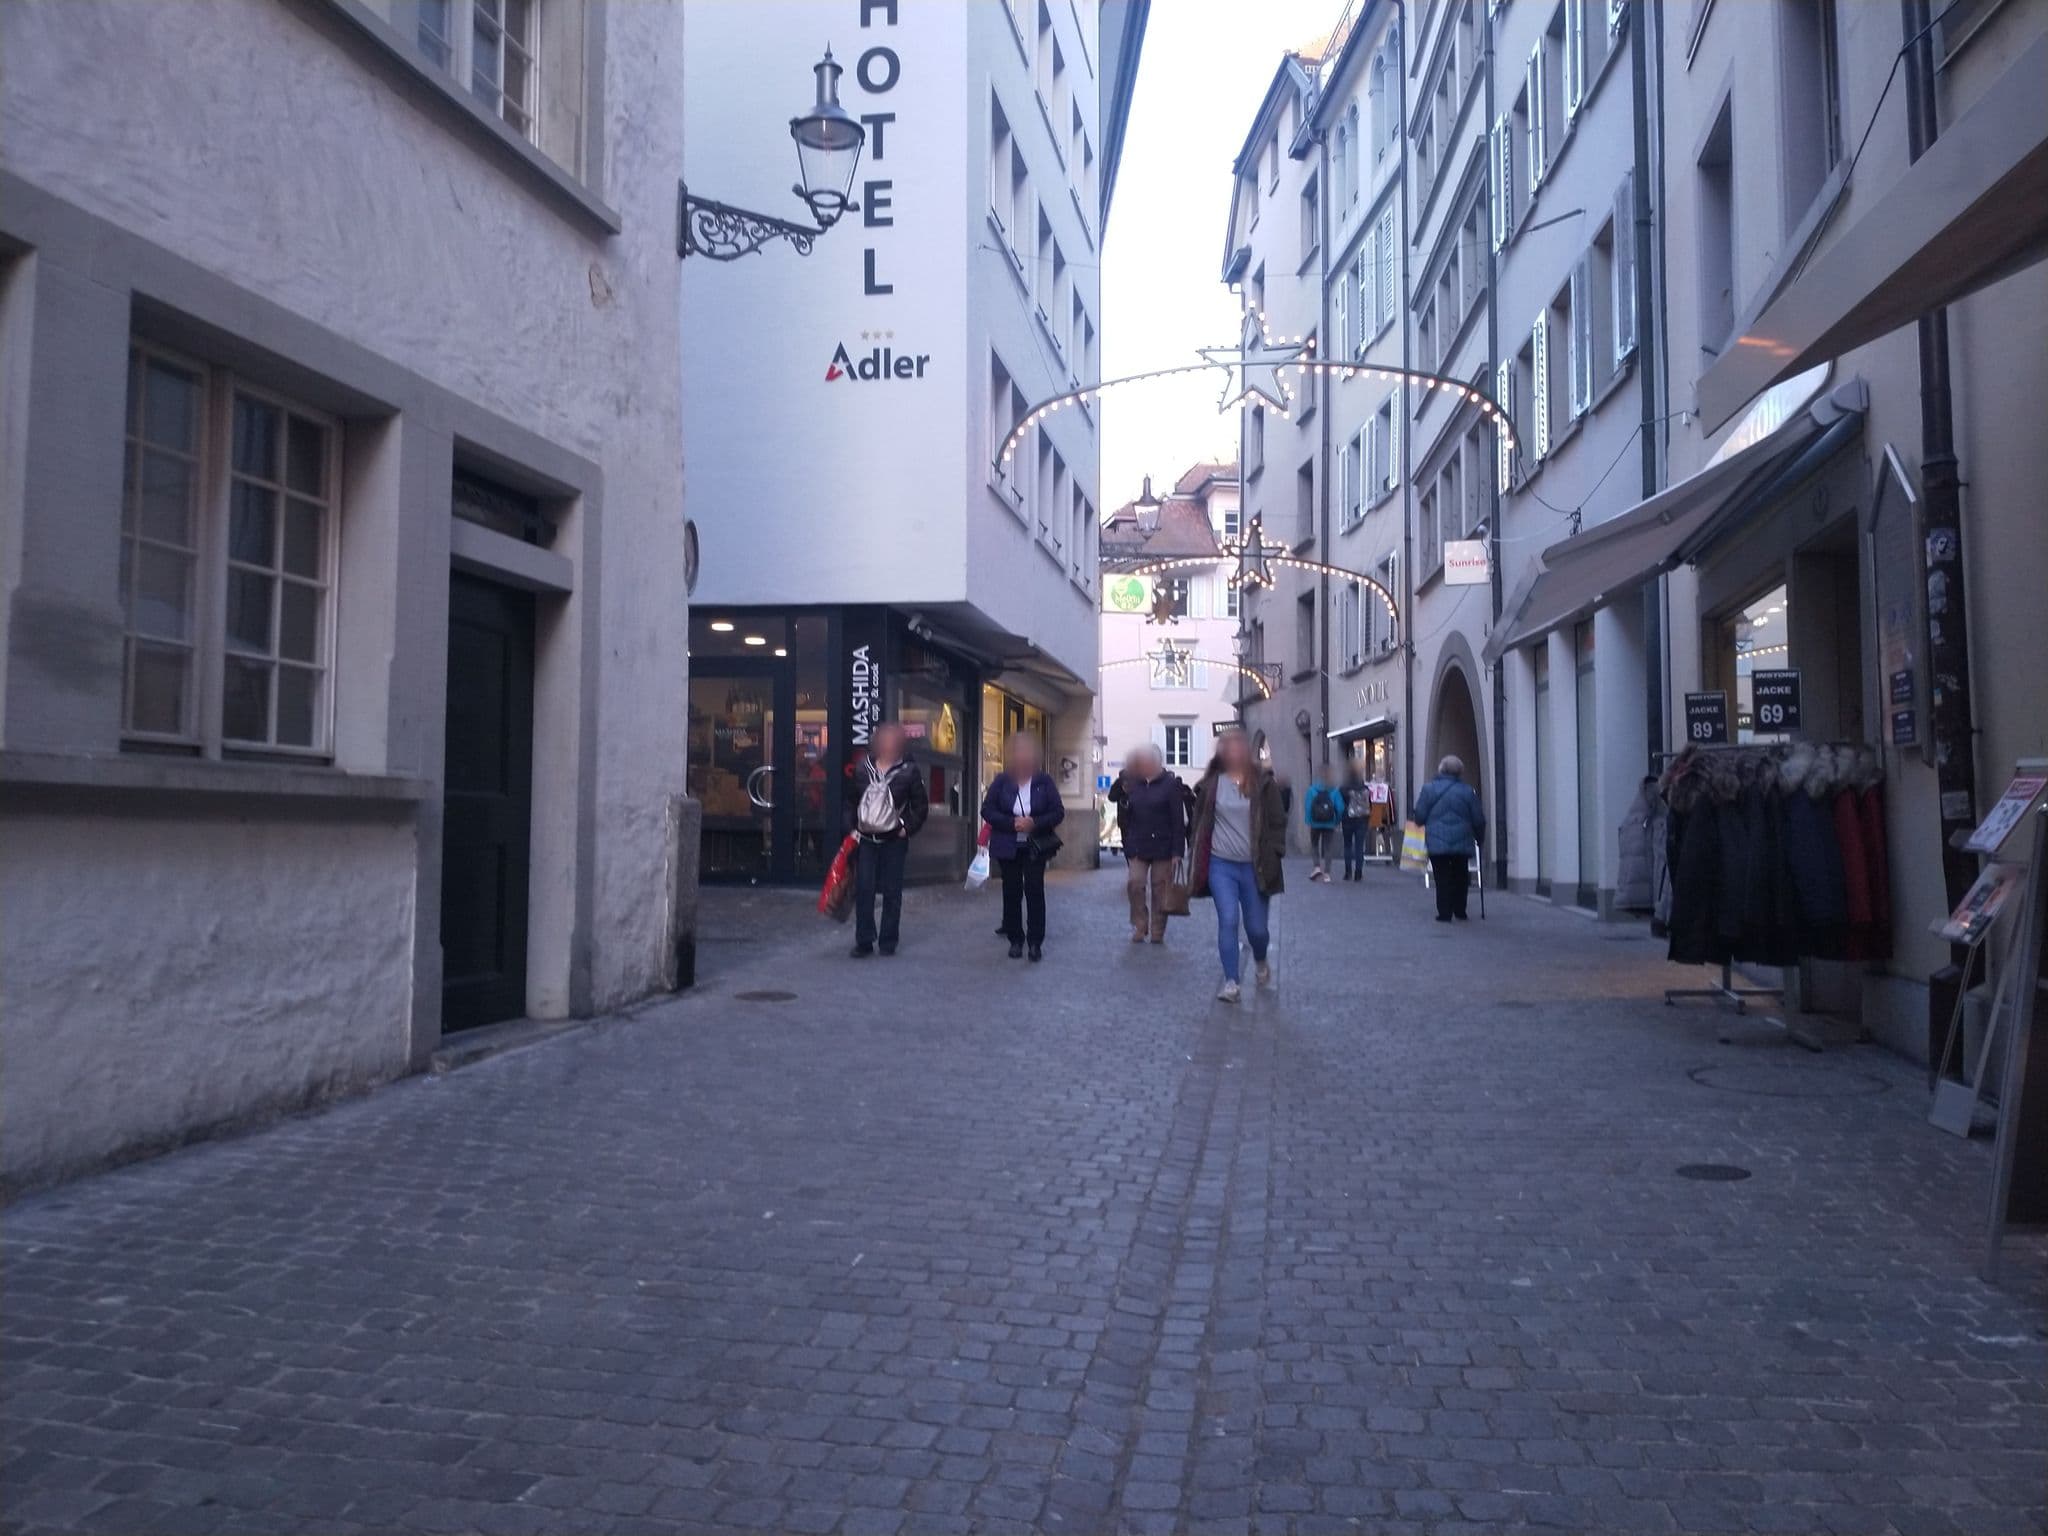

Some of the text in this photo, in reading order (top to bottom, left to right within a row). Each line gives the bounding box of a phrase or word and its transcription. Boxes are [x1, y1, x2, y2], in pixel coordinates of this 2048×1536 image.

[857, 0, 901, 295] HOTEL
[825, 341, 930, 381] Adler
[1448, 557, 1487, 568] Sunrise
[851, 644, 870, 745] MASHIDA
[1756, 686, 1792, 695] JACKE
[1760, 704, 1783, 723] 69
[1693, 722, 1712, 738] 89
